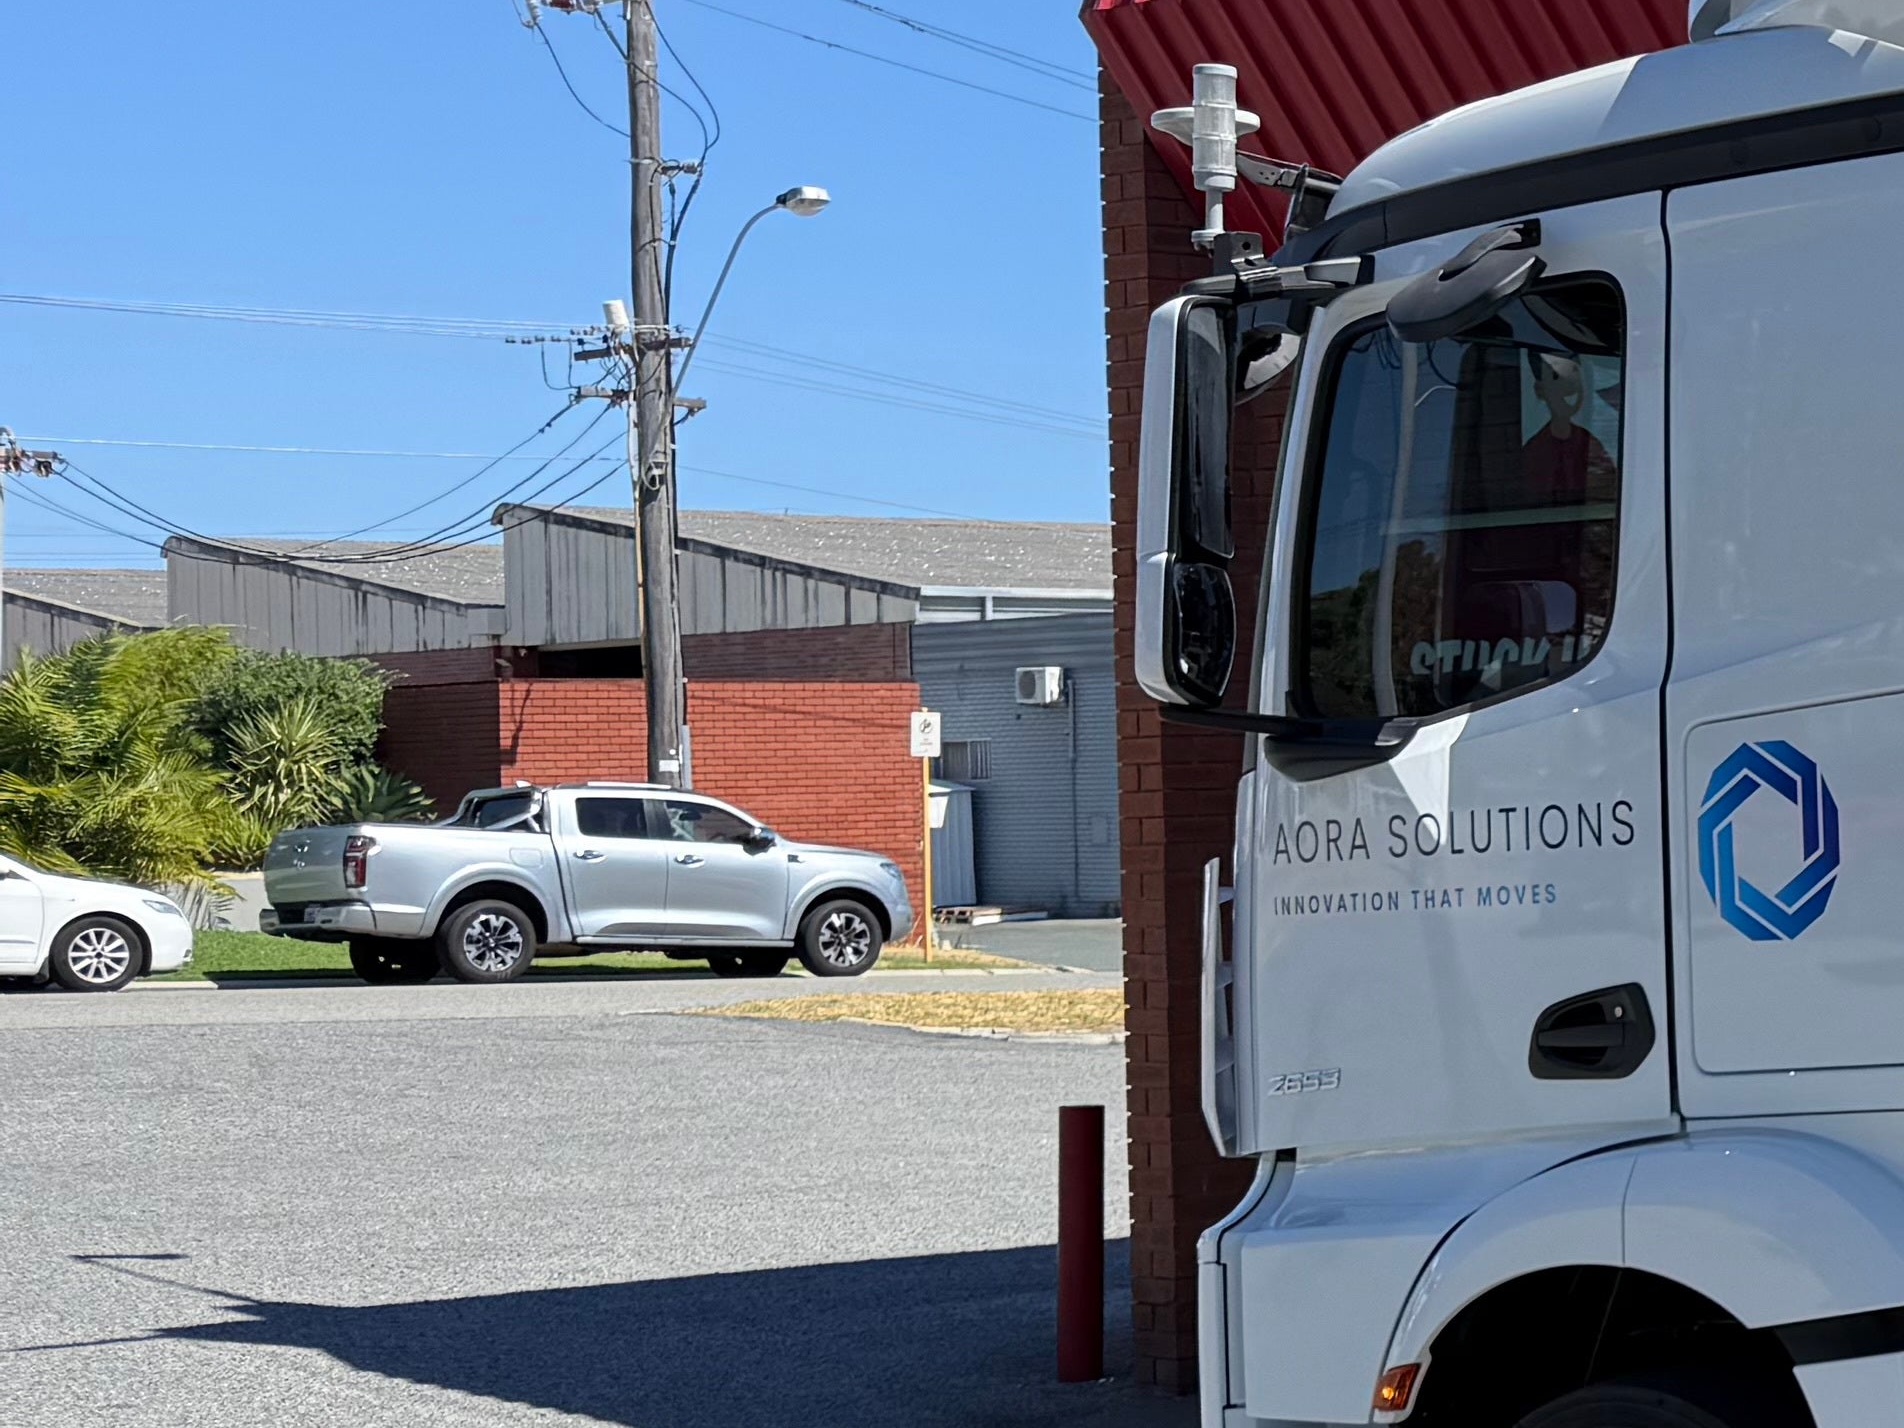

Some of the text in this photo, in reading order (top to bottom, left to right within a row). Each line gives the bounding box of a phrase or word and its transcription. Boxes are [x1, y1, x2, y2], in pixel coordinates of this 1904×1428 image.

[1273, 800, 1635, 865] AORA SOLUTIONS
[1274, 884, 1558, 916] INNOVATION THAT MOVES
[1267, 1068, 1341, 1097] 2653
